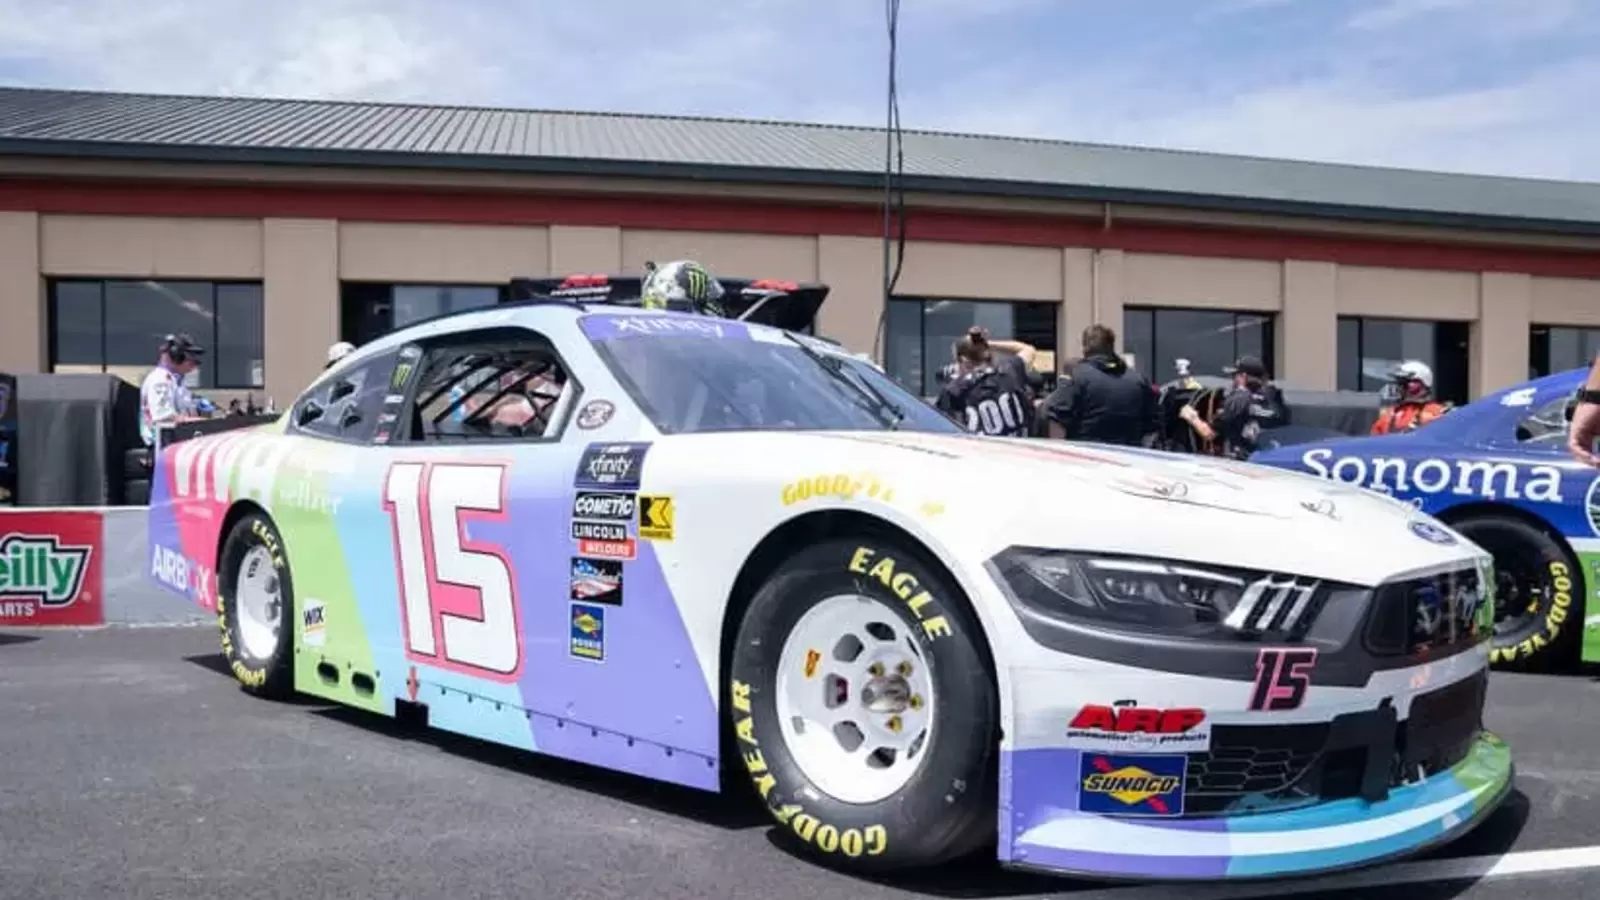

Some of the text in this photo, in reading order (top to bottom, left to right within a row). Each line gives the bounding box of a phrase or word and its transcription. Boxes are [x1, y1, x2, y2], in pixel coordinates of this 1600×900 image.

[1302, 448, 1563, 504] Sonoma
[575, 496, 635, 517] COMETIC
[573, 524, 625, 541] LINCOLN
[381, 457, 527, 684] 15
[848, 547, 953, 641] EAGLE
[303, 606, 325, 627] WIX
[1247, 647, 1318, 712] 15
[1068, 704, 1207, 734] ARP
[731, 679, 888, 857] GOODYEAR
[1085, 773, 1178, 793] SUNOCO
